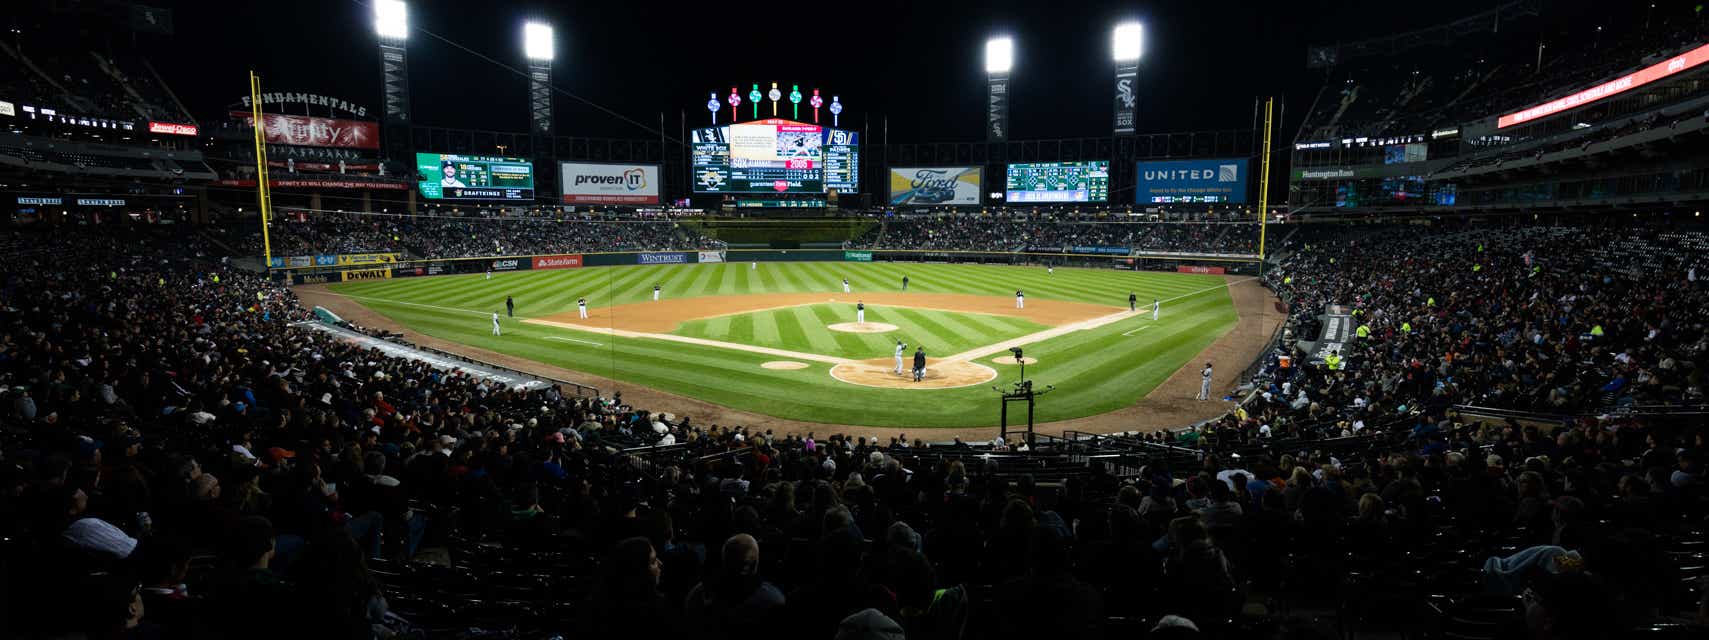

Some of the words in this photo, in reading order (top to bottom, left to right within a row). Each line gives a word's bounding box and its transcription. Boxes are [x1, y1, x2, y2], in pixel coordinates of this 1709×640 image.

[733, 159, 747, 168] SOX
[575, 175, 623, 186] proven
[629, 174, 641, 185] IT
[911, 169, 959, 190] Ford
[1144, 169, 1215, 181] UNITED
[641, 254, 683, 262] WINTRUST
